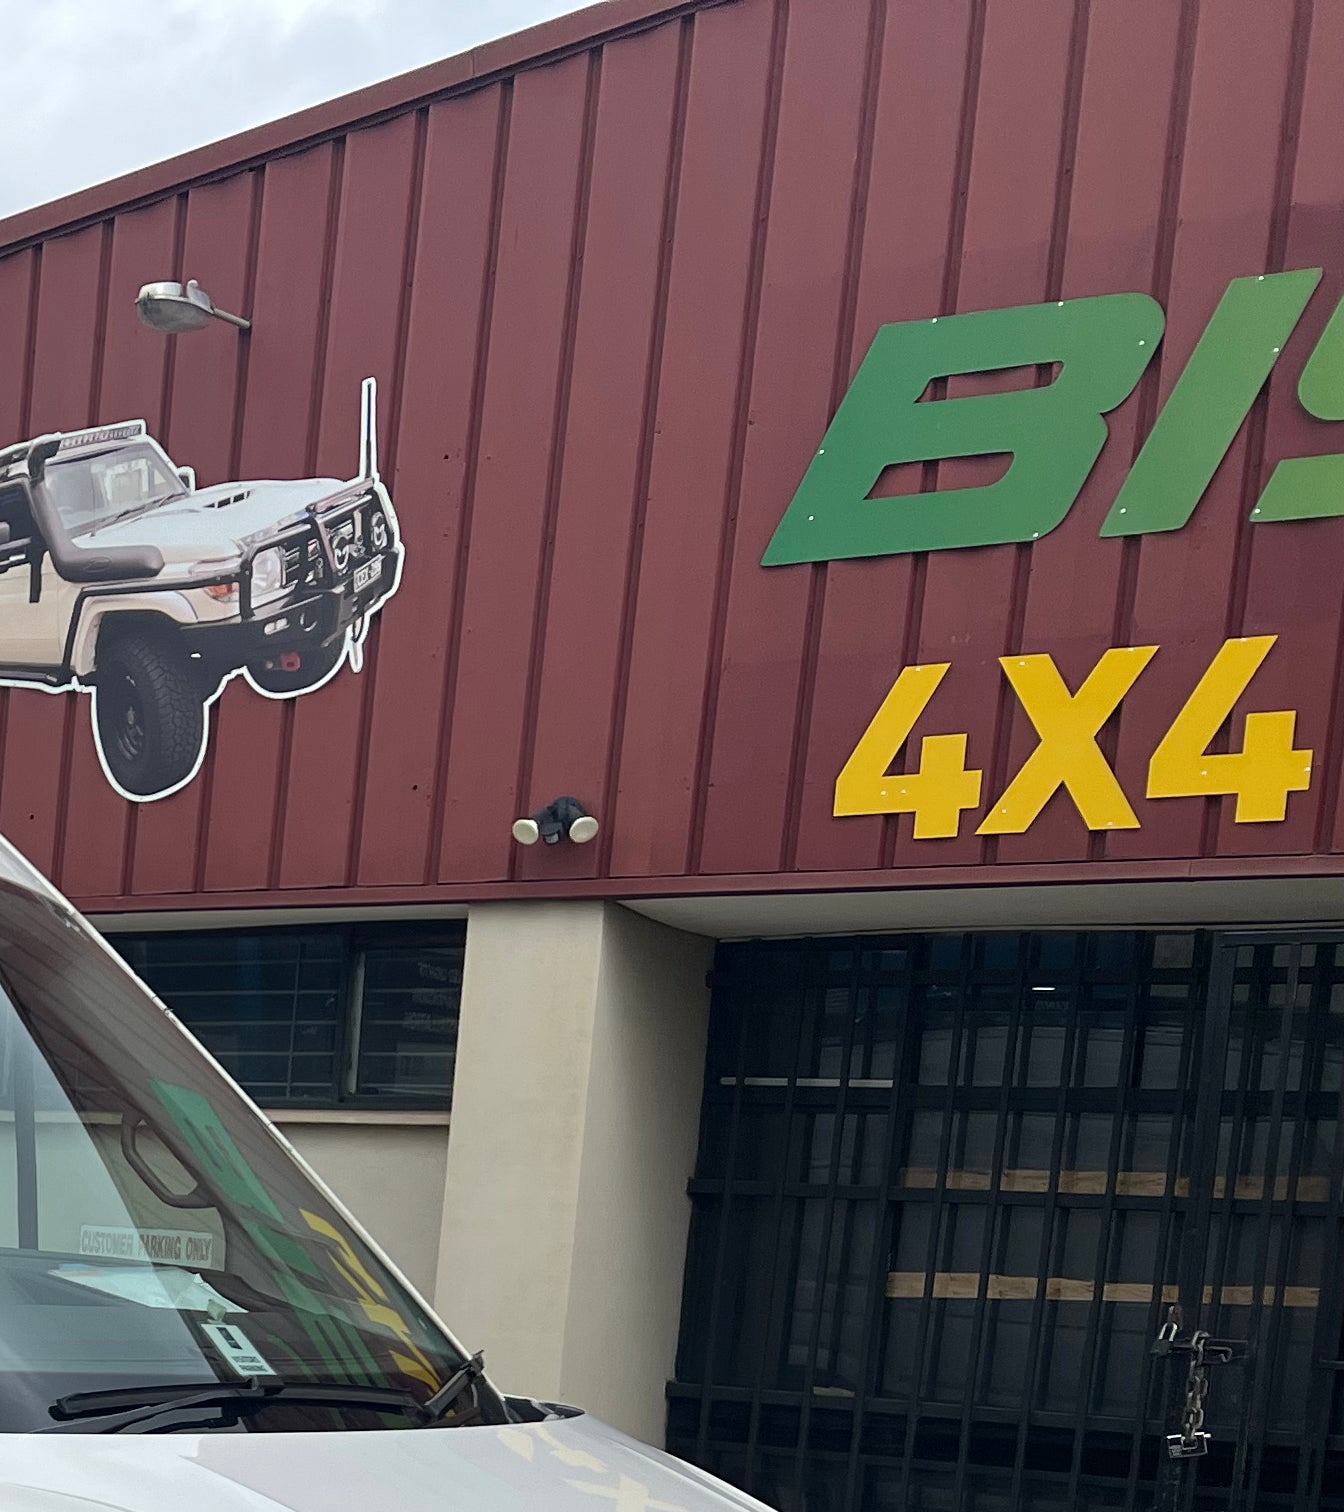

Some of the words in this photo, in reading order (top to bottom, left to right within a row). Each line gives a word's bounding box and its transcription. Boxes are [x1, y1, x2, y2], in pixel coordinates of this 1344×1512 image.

[760, 266, 1344, 567] BI
[832, 634, 1315, 841] 4X4
[81, 1229, 134, 1255] CUSTOMER
[137, 1233, 182, 1261] PARKING
[185, 1236, 212, 1263] ONLY
